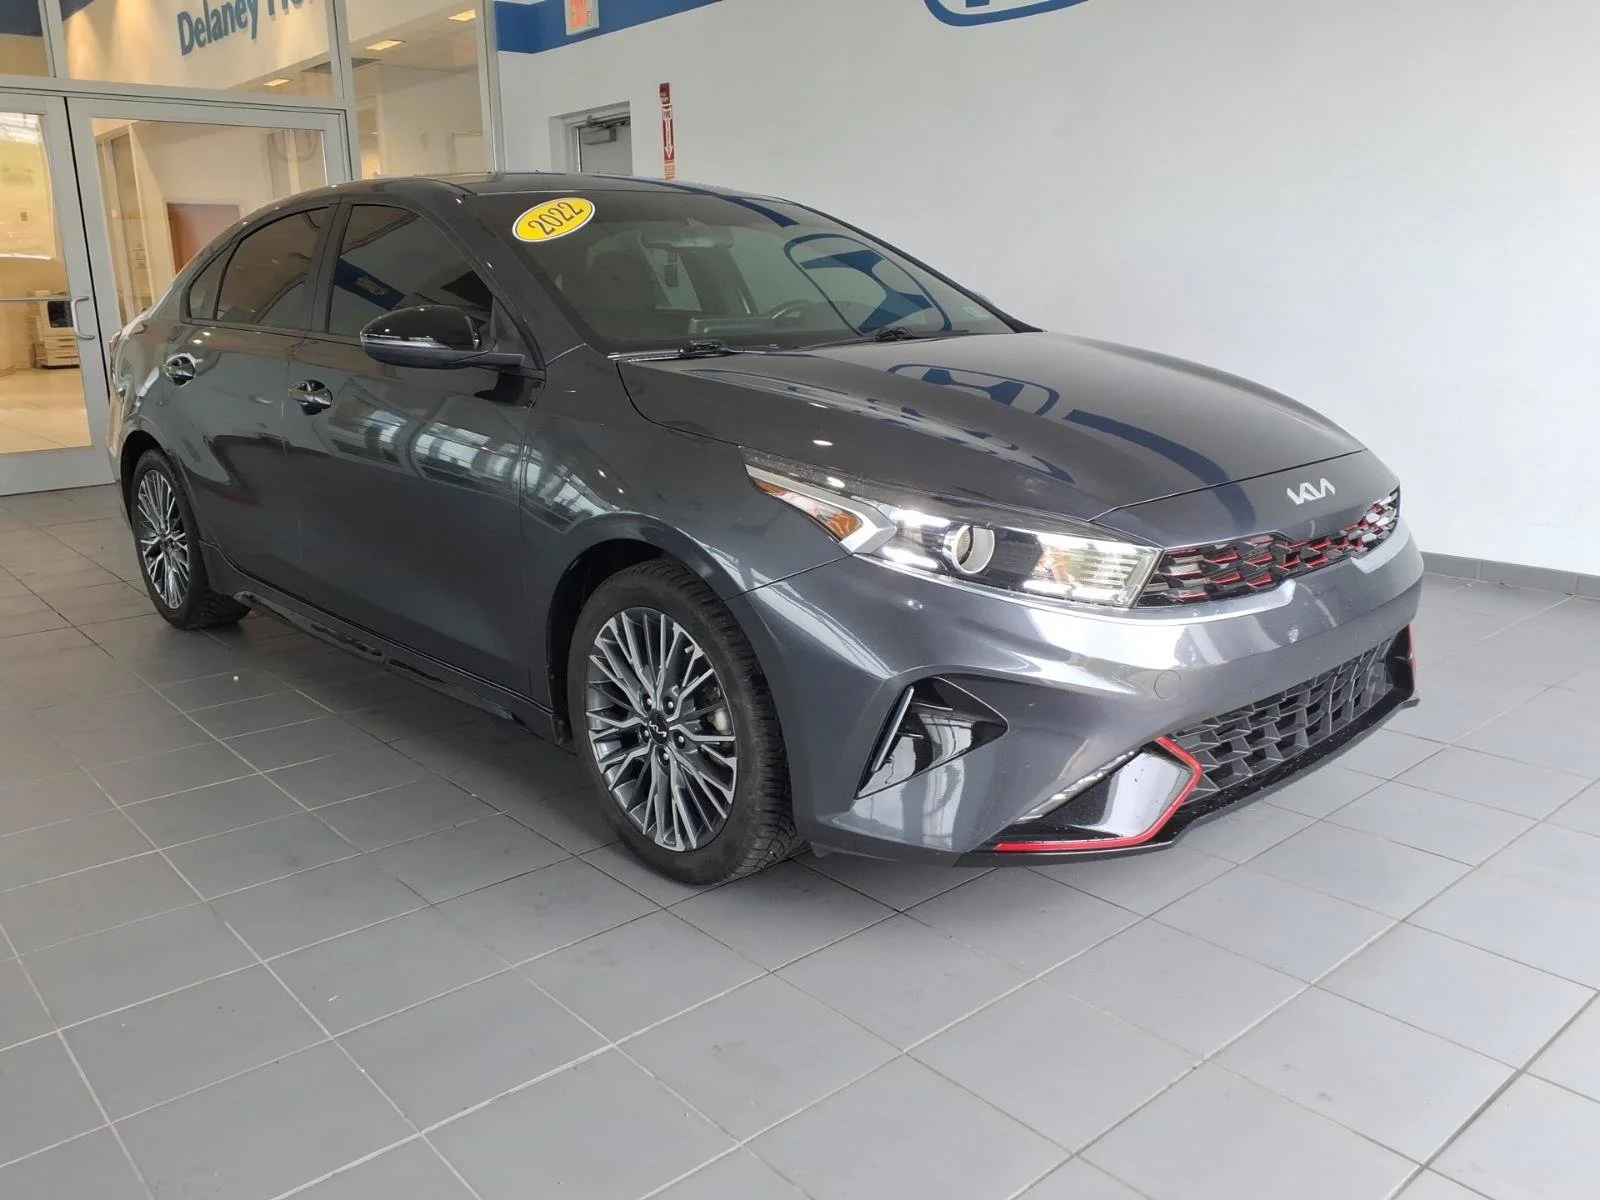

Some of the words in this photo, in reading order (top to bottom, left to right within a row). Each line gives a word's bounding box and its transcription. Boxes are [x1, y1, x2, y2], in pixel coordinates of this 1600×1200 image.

[177, 0, 259, 56] Delaney
[528, 202, 584, 235] 2022
[1287, 478, 1336, 505] KIA
